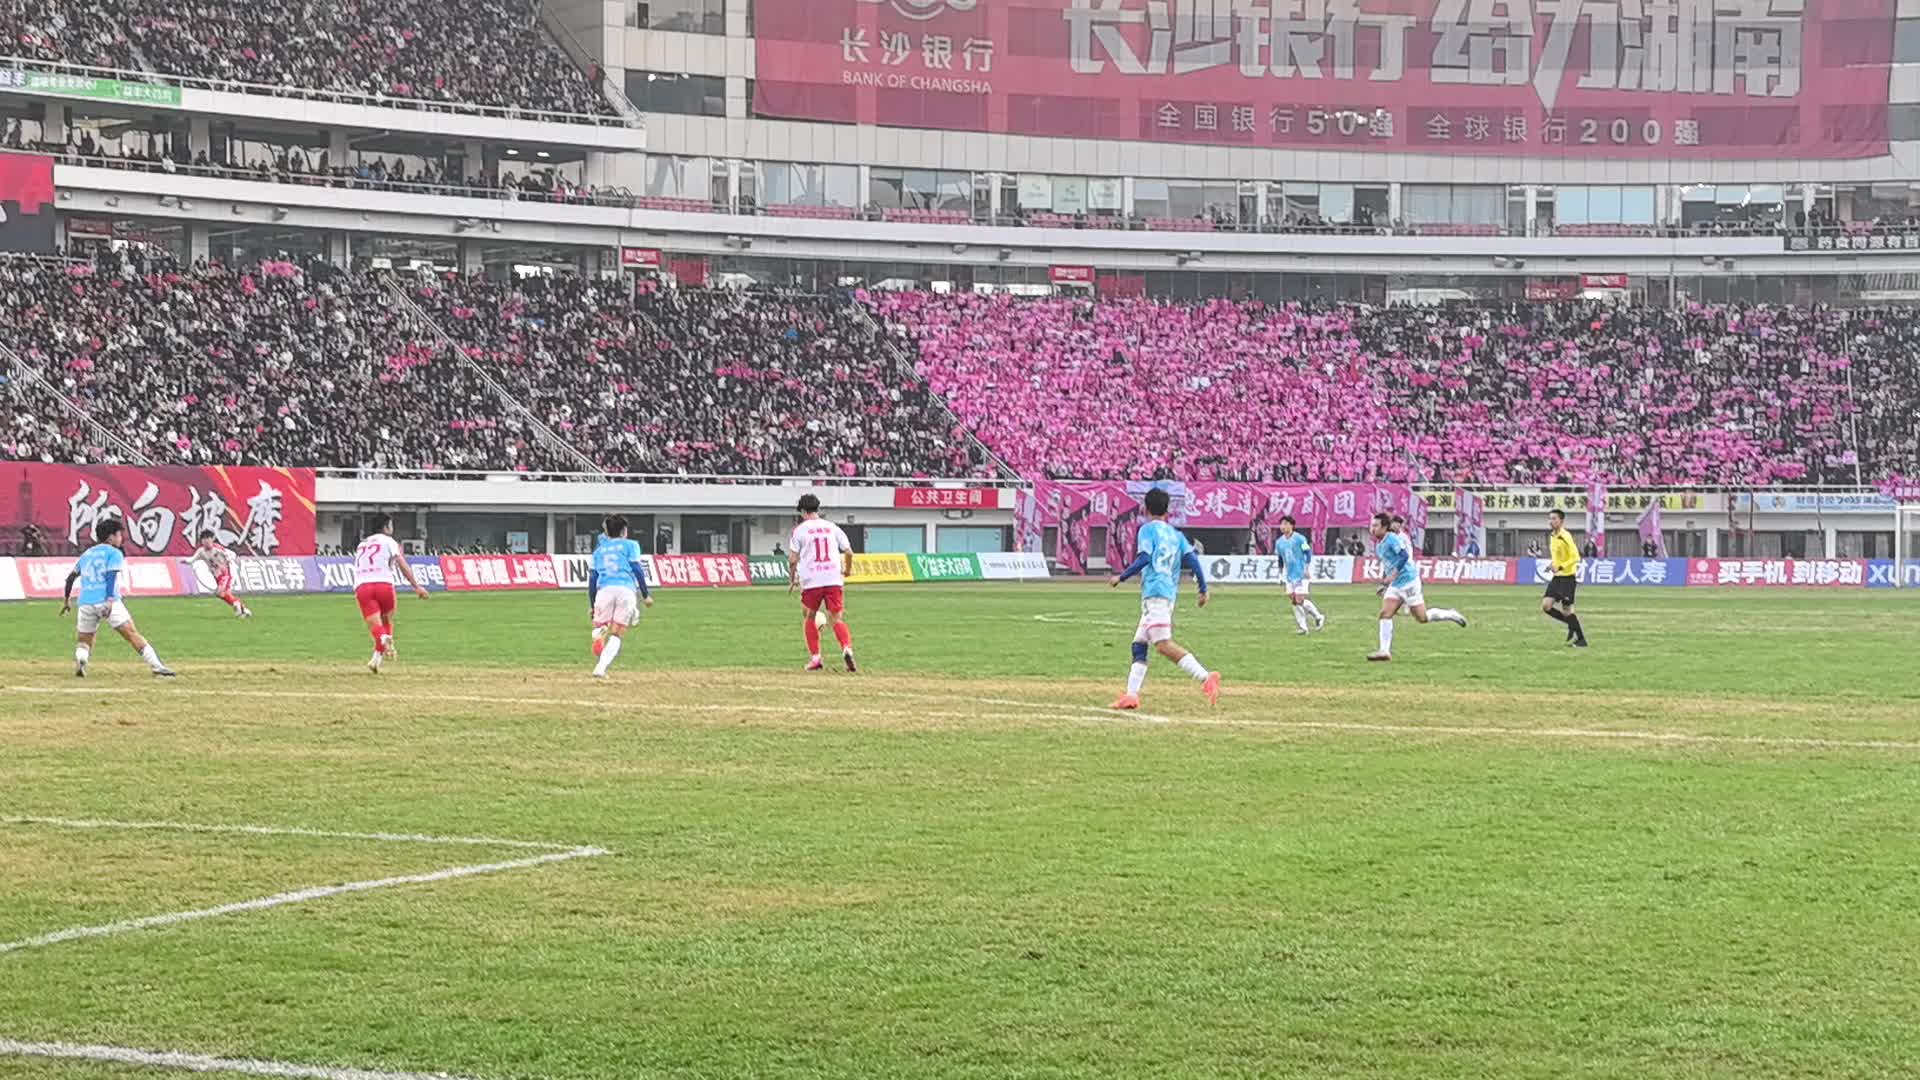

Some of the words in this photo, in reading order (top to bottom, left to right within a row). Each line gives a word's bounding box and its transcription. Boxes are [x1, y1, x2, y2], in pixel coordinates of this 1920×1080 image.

[840, 28, 993, 72] 长沙银行
[843, 71, 884, 87] BANK
[887, 74, 906, 88] OF
[910, 76, 993, 95] CHANGSHA
[1426, 113, 1700, 145] 全球银行200强
[910, 489, 983, 506] 公共卫生间
[68, 480, 282, 556] 所向披靡
[813, 537, 831, 562] 11
[1238, 558, 1338, 580] 点石装
[1717, 560, 1787, 584] 买手机
[1791, 560, 1863, 584] 到移动
